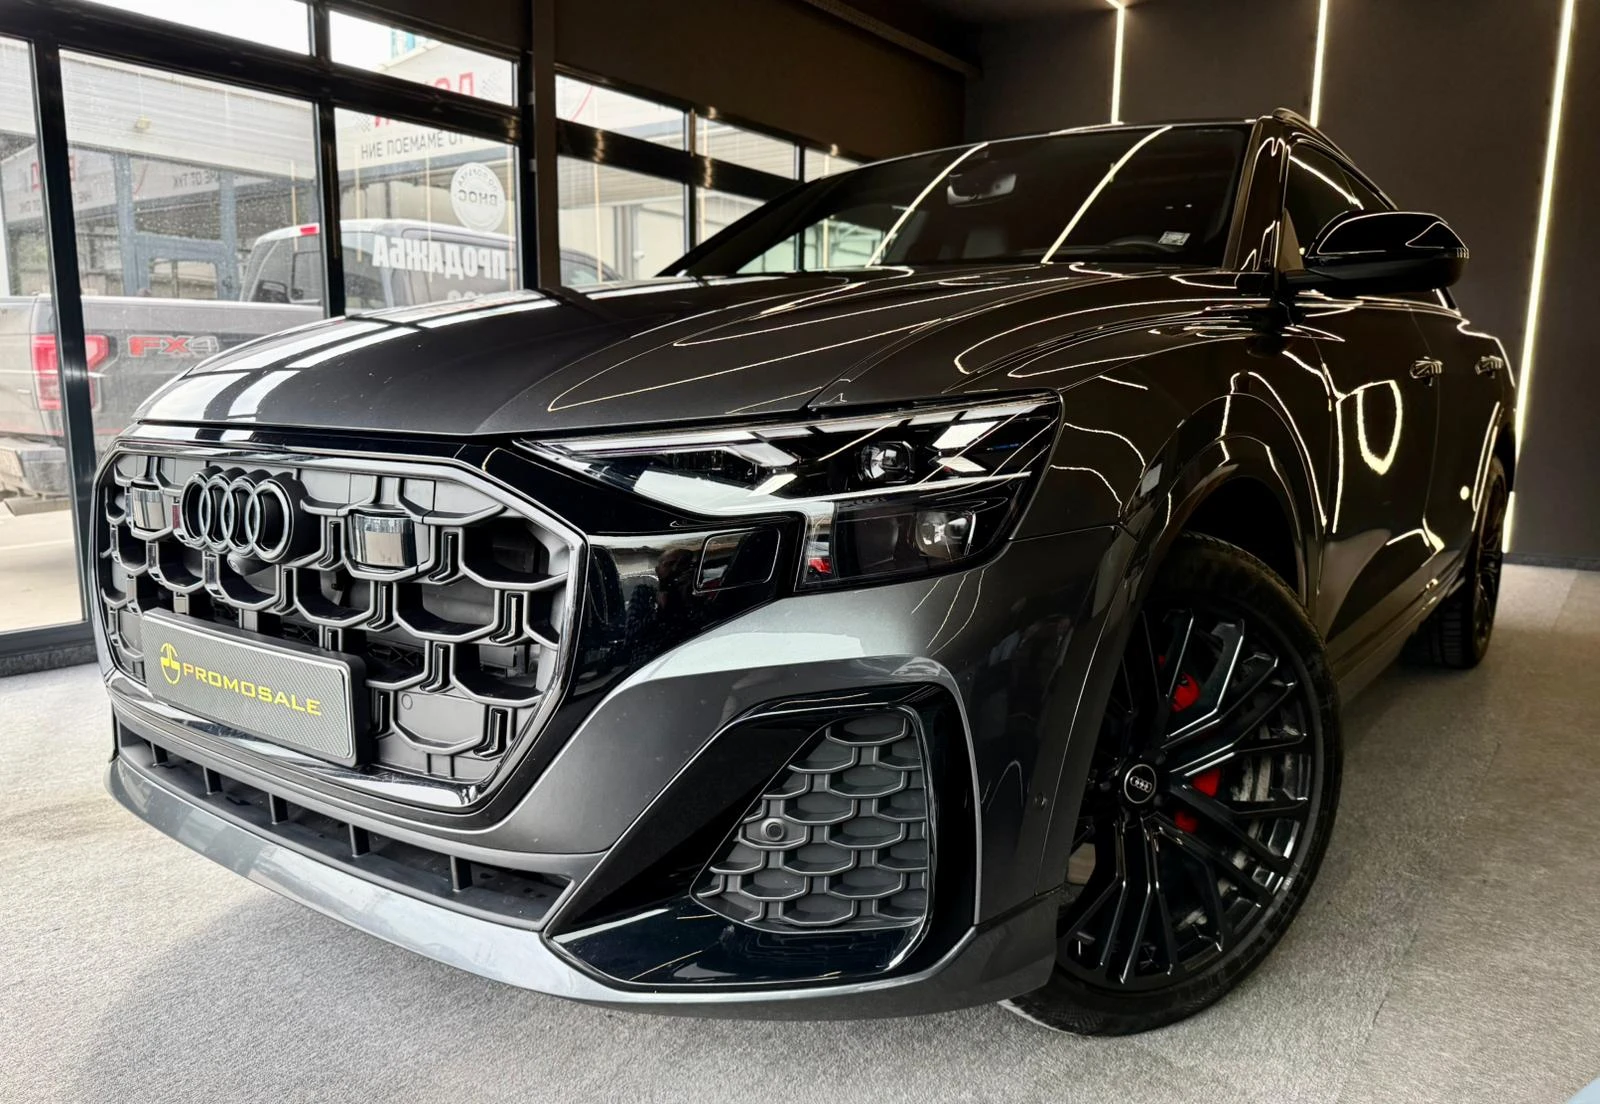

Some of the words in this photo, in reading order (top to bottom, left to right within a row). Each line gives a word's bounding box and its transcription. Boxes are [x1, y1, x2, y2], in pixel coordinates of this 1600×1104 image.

[361, 142, 382, 160] НИЕ
[386, 131, 443, 155] ПОЕМАМЕ
[127, 335, 219, 358] FX4
[183, 662, 321, 716] PROMOSALE
